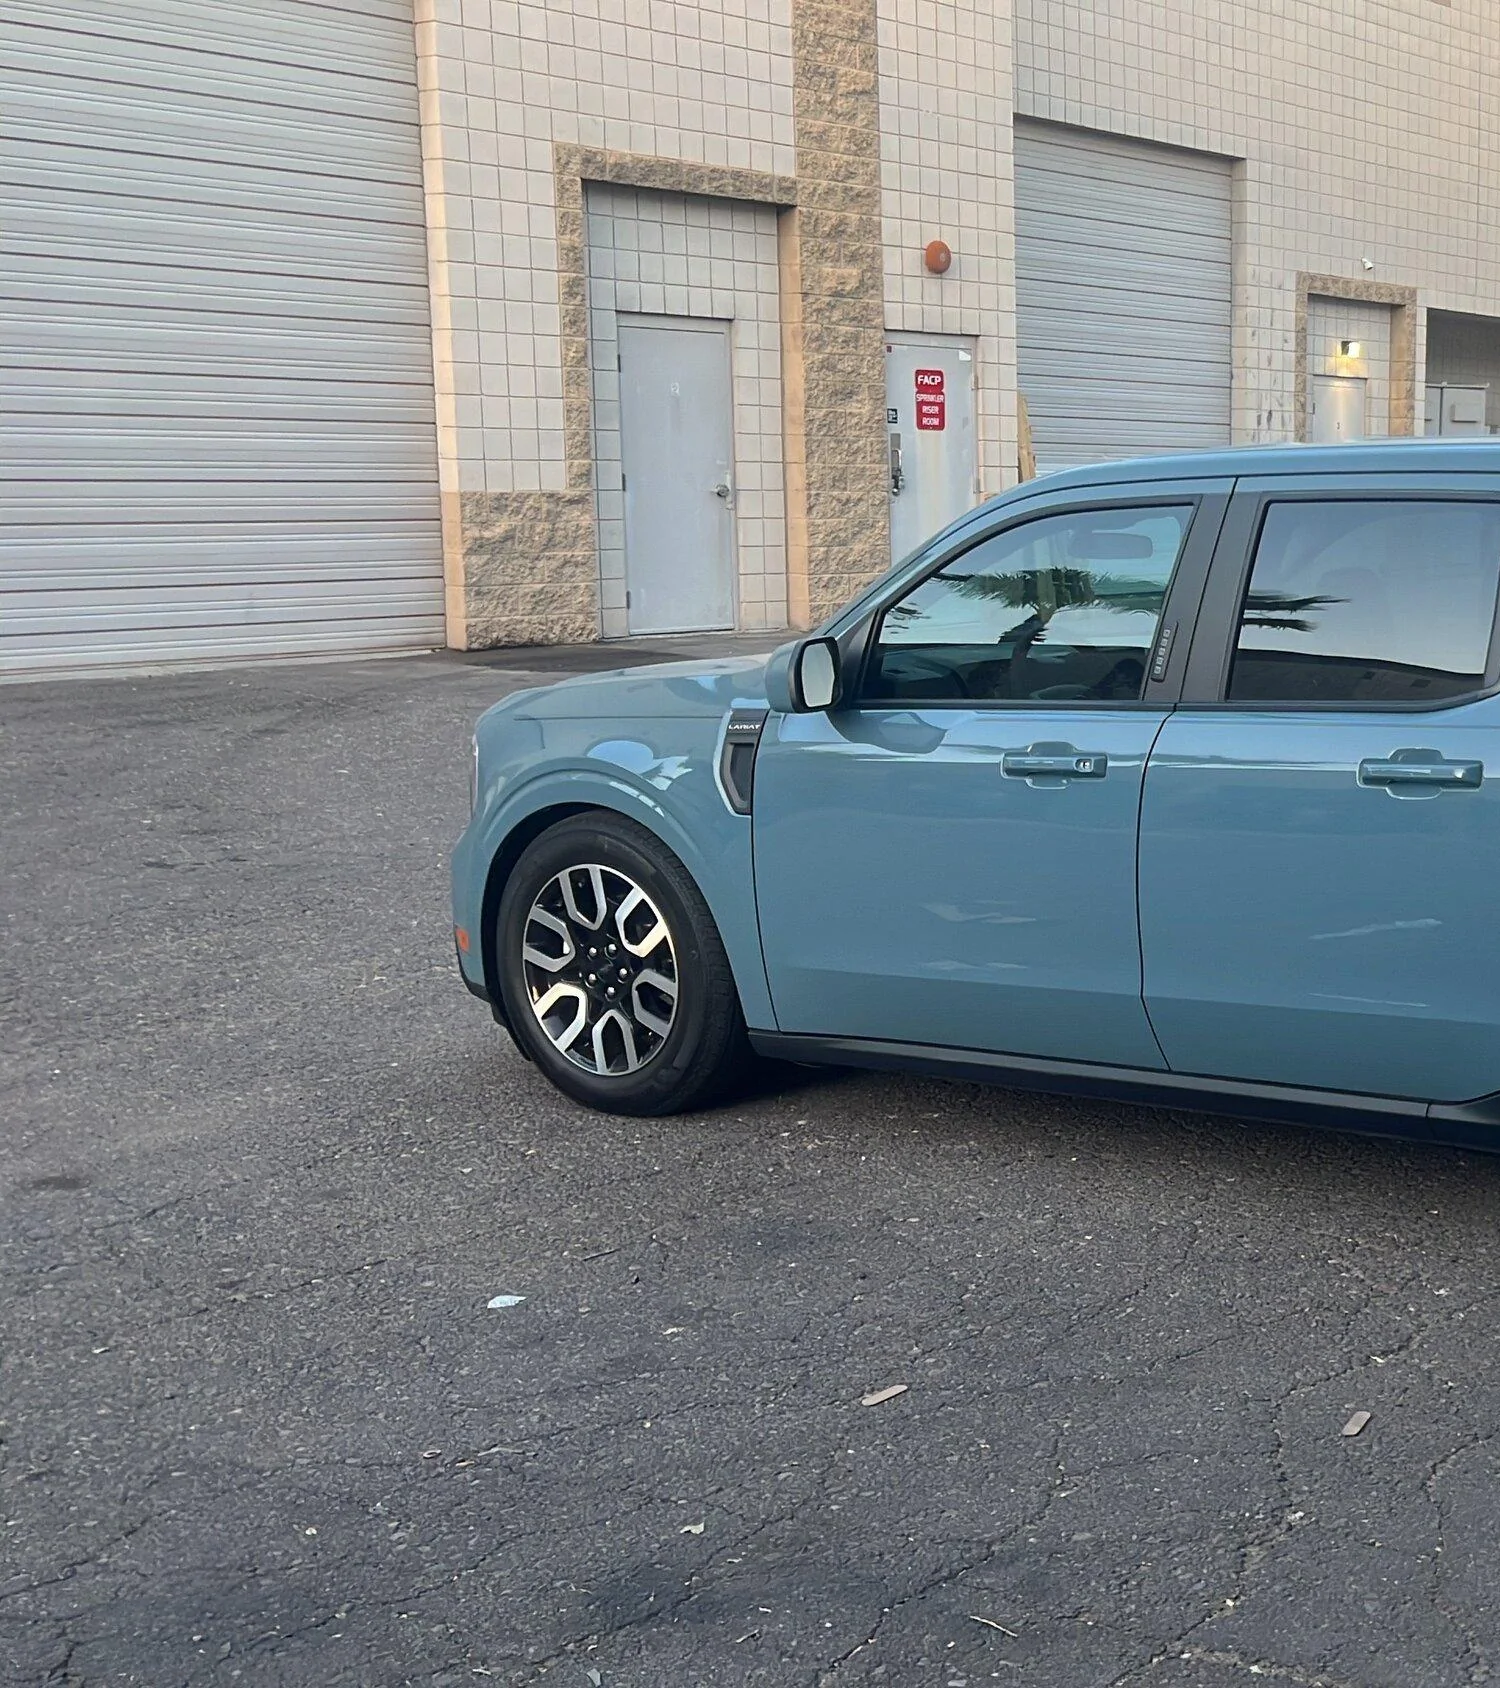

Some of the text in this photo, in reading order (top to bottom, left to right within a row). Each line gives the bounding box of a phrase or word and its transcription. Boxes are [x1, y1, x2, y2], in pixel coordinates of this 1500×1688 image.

[917, 374, 942, 385] FACP
[922, 405, 939, 414] RISER
[922, 416, 940, 425] ROOM
